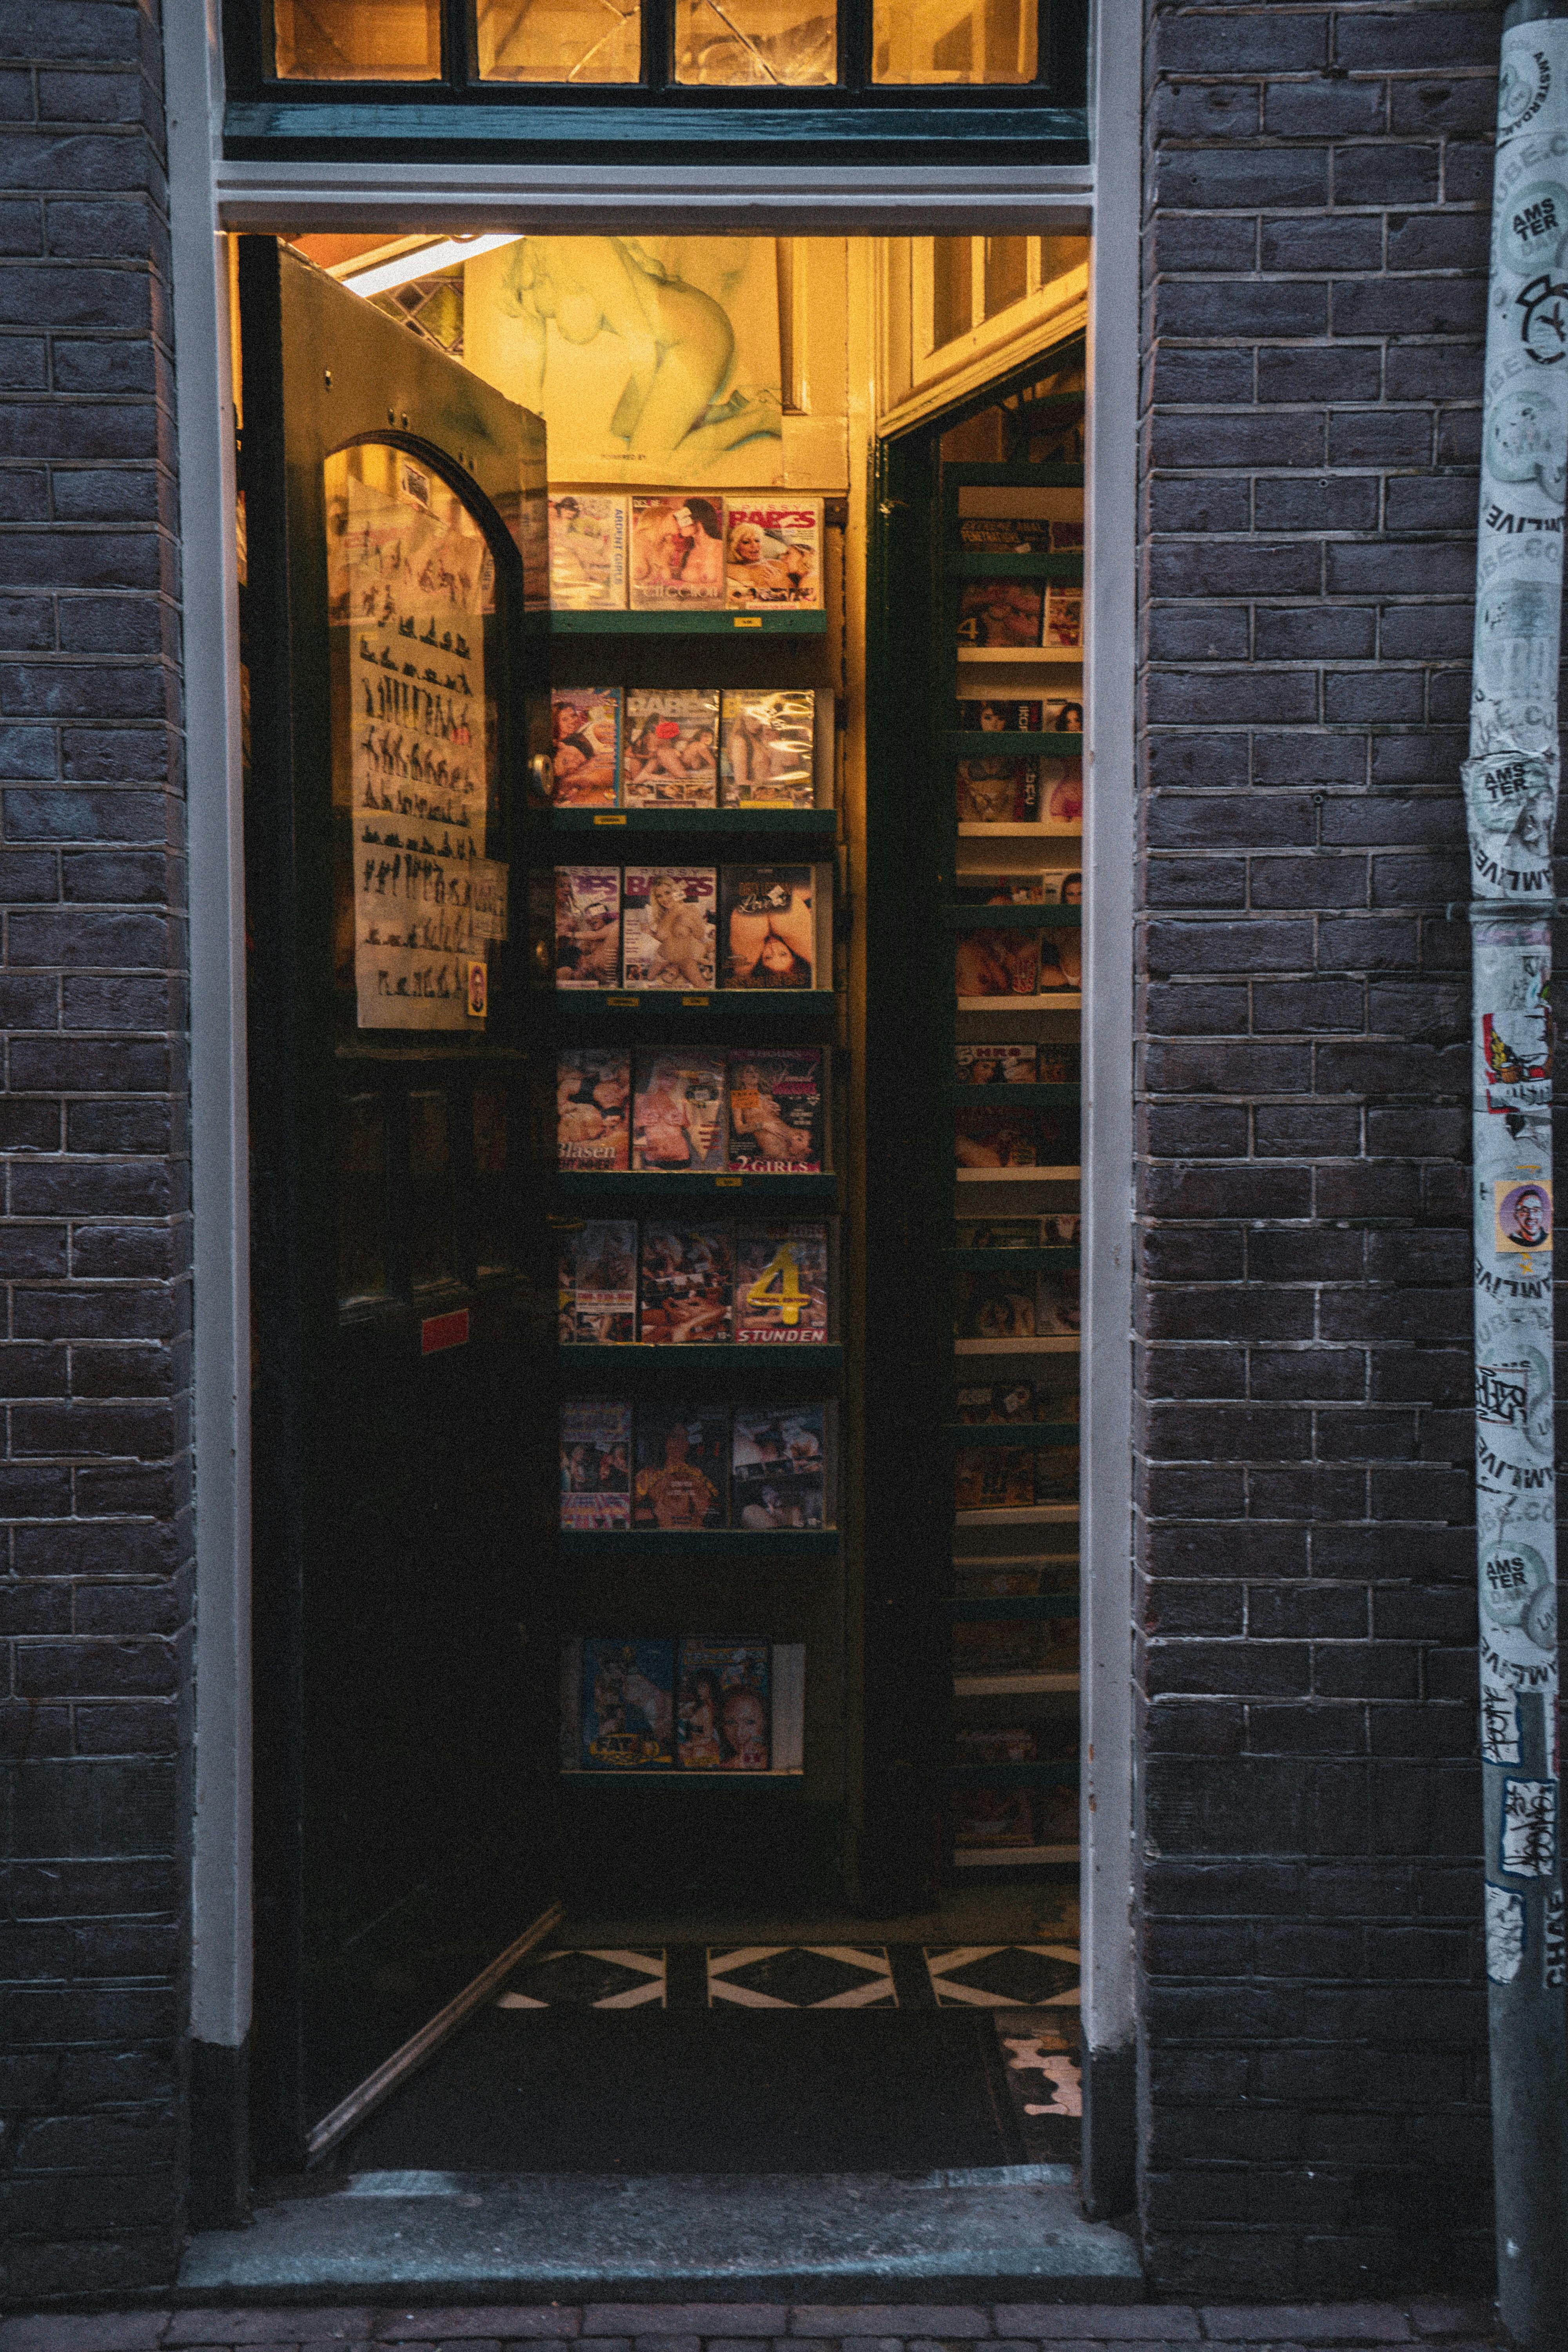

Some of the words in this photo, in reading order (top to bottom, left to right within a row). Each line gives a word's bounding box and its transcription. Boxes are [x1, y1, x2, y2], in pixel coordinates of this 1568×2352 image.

[1513, 198, 1555, 232] AMS
[1515, 214, 1558, 241] TER
[1485, 763, 1525, 786] AMS
[1486, 778, 1528, 799] TER
[737, 1155, 750, 1171] 2
[751, 1160, 809, 1172] GIRLS
[747, 1241, 811, 1325] 4
[738, 1330, 825, 1342] STUNDEN
[1486, 1557, 1524, 1576] AMS
[1488, 1572, 1527, 1590] TER
